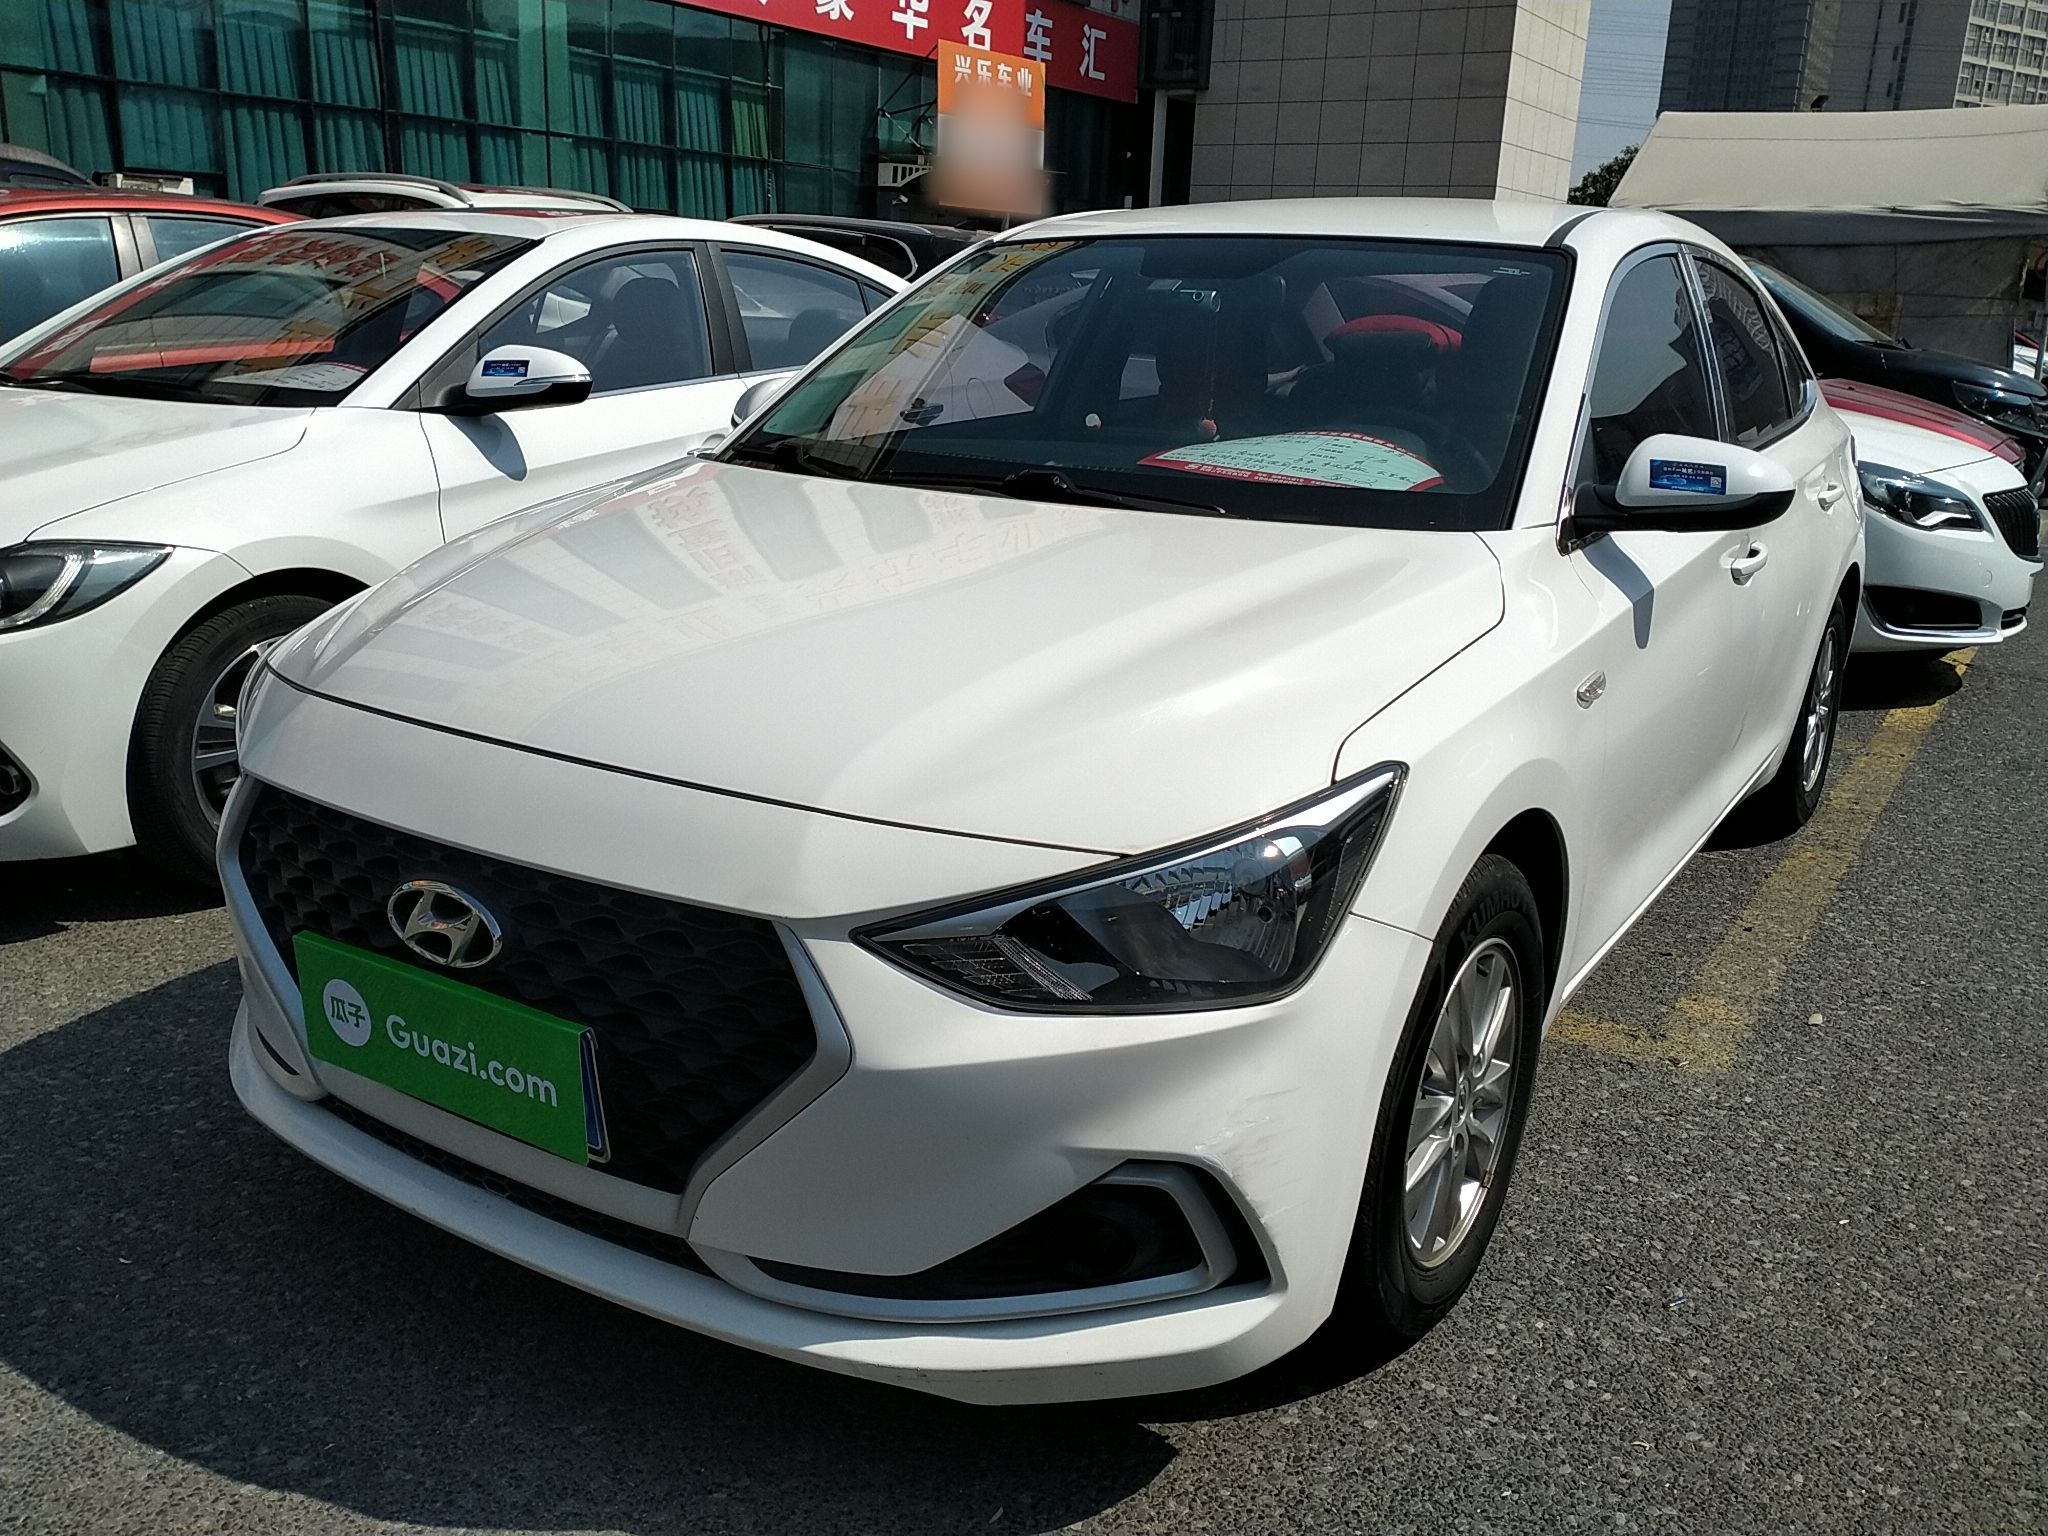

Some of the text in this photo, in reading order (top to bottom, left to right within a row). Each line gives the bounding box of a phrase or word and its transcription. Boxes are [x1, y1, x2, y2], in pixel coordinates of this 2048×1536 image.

[954, 53, 1033, 97] 兴乐车业
[330, 995, 366, 1028] 瓜子
[386, 1014, 559, 1108] Guazi.com
